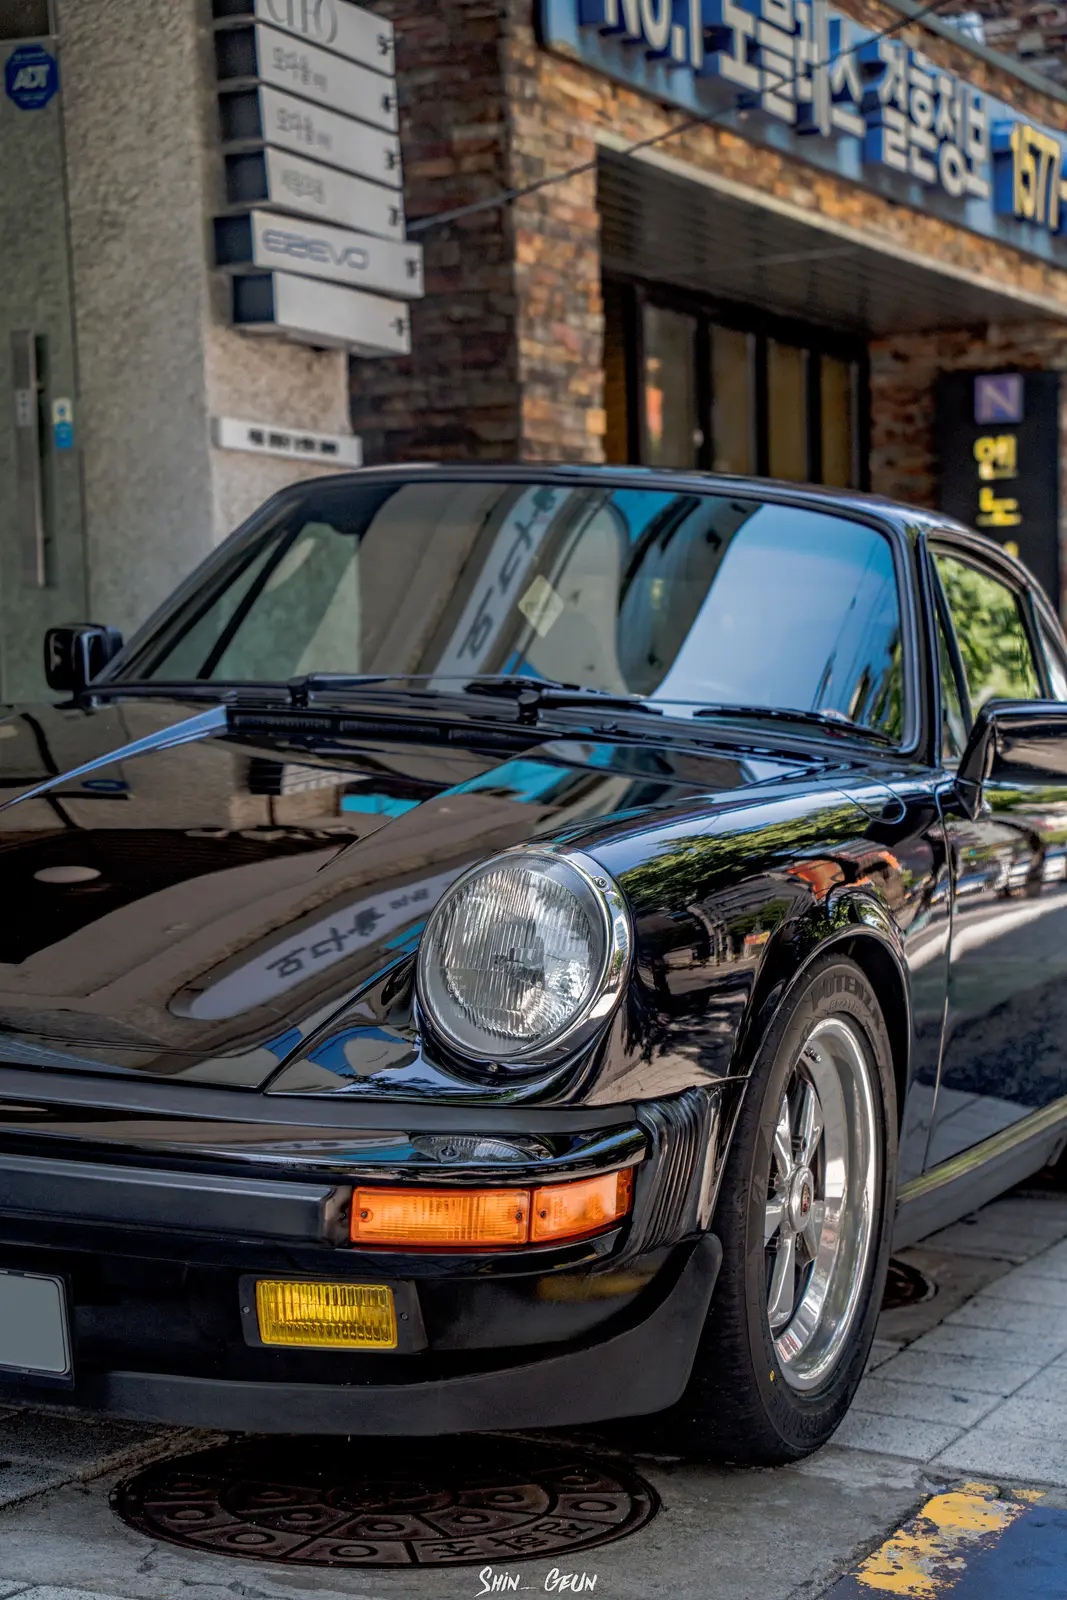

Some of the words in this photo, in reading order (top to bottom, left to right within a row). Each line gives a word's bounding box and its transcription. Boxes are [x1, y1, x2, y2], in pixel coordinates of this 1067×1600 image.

[12, 64, 51, 91] ADT
[878, 41, 992, 199] 결혼정보
[973, 434, 1022, 560] 엔노
[811, 973, 880, 1031] POTENZA
